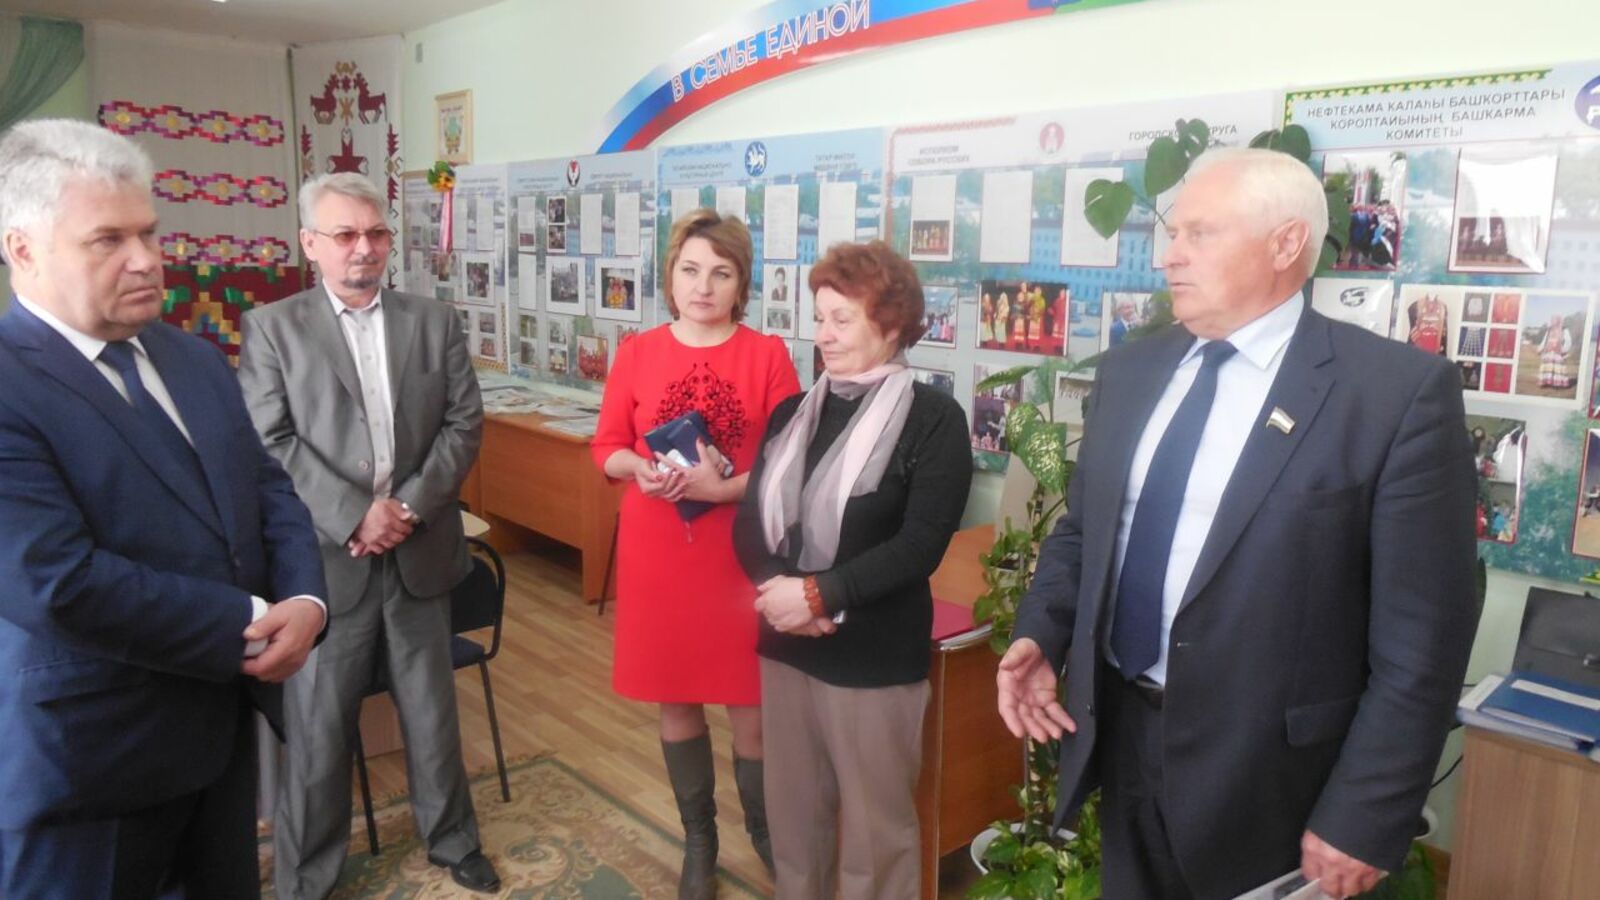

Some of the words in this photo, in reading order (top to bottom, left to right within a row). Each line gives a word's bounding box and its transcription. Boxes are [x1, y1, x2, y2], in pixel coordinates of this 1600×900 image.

[671, 73, 685, 103] В
[689, 35, 758, 90] СЕМЬЕ
[1307, 103, 1384, 119] НЕФТЕКАМА
[1386, 127, 1463, 141] КОМИТЕТЫ
